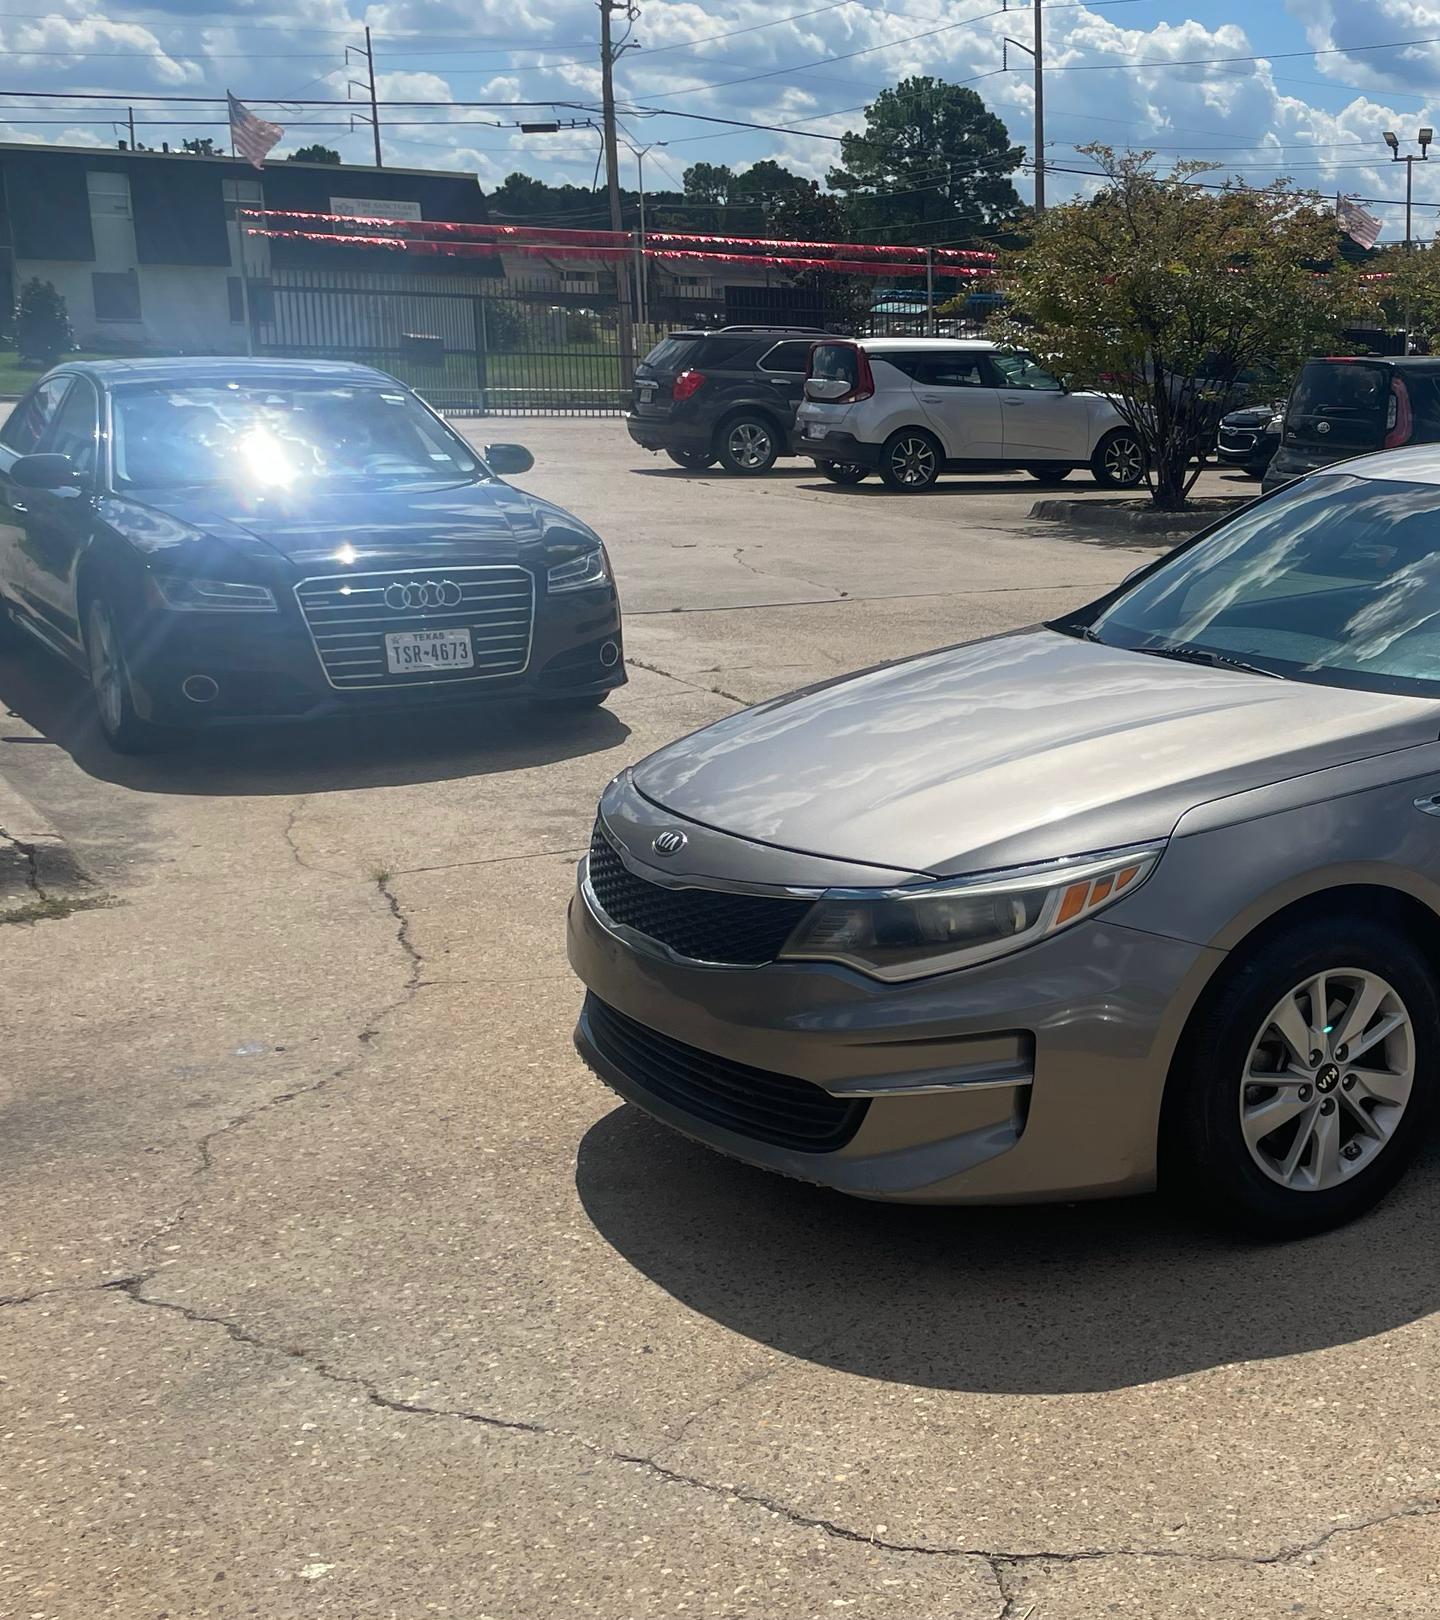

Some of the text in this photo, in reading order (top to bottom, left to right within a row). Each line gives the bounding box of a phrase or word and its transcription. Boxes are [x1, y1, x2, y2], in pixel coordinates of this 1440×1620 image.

[413, 632, 445, 641] TEXAS
[656, 831, 680, 851] KIA
[1318, 1067, 1338, 1089] KIA
